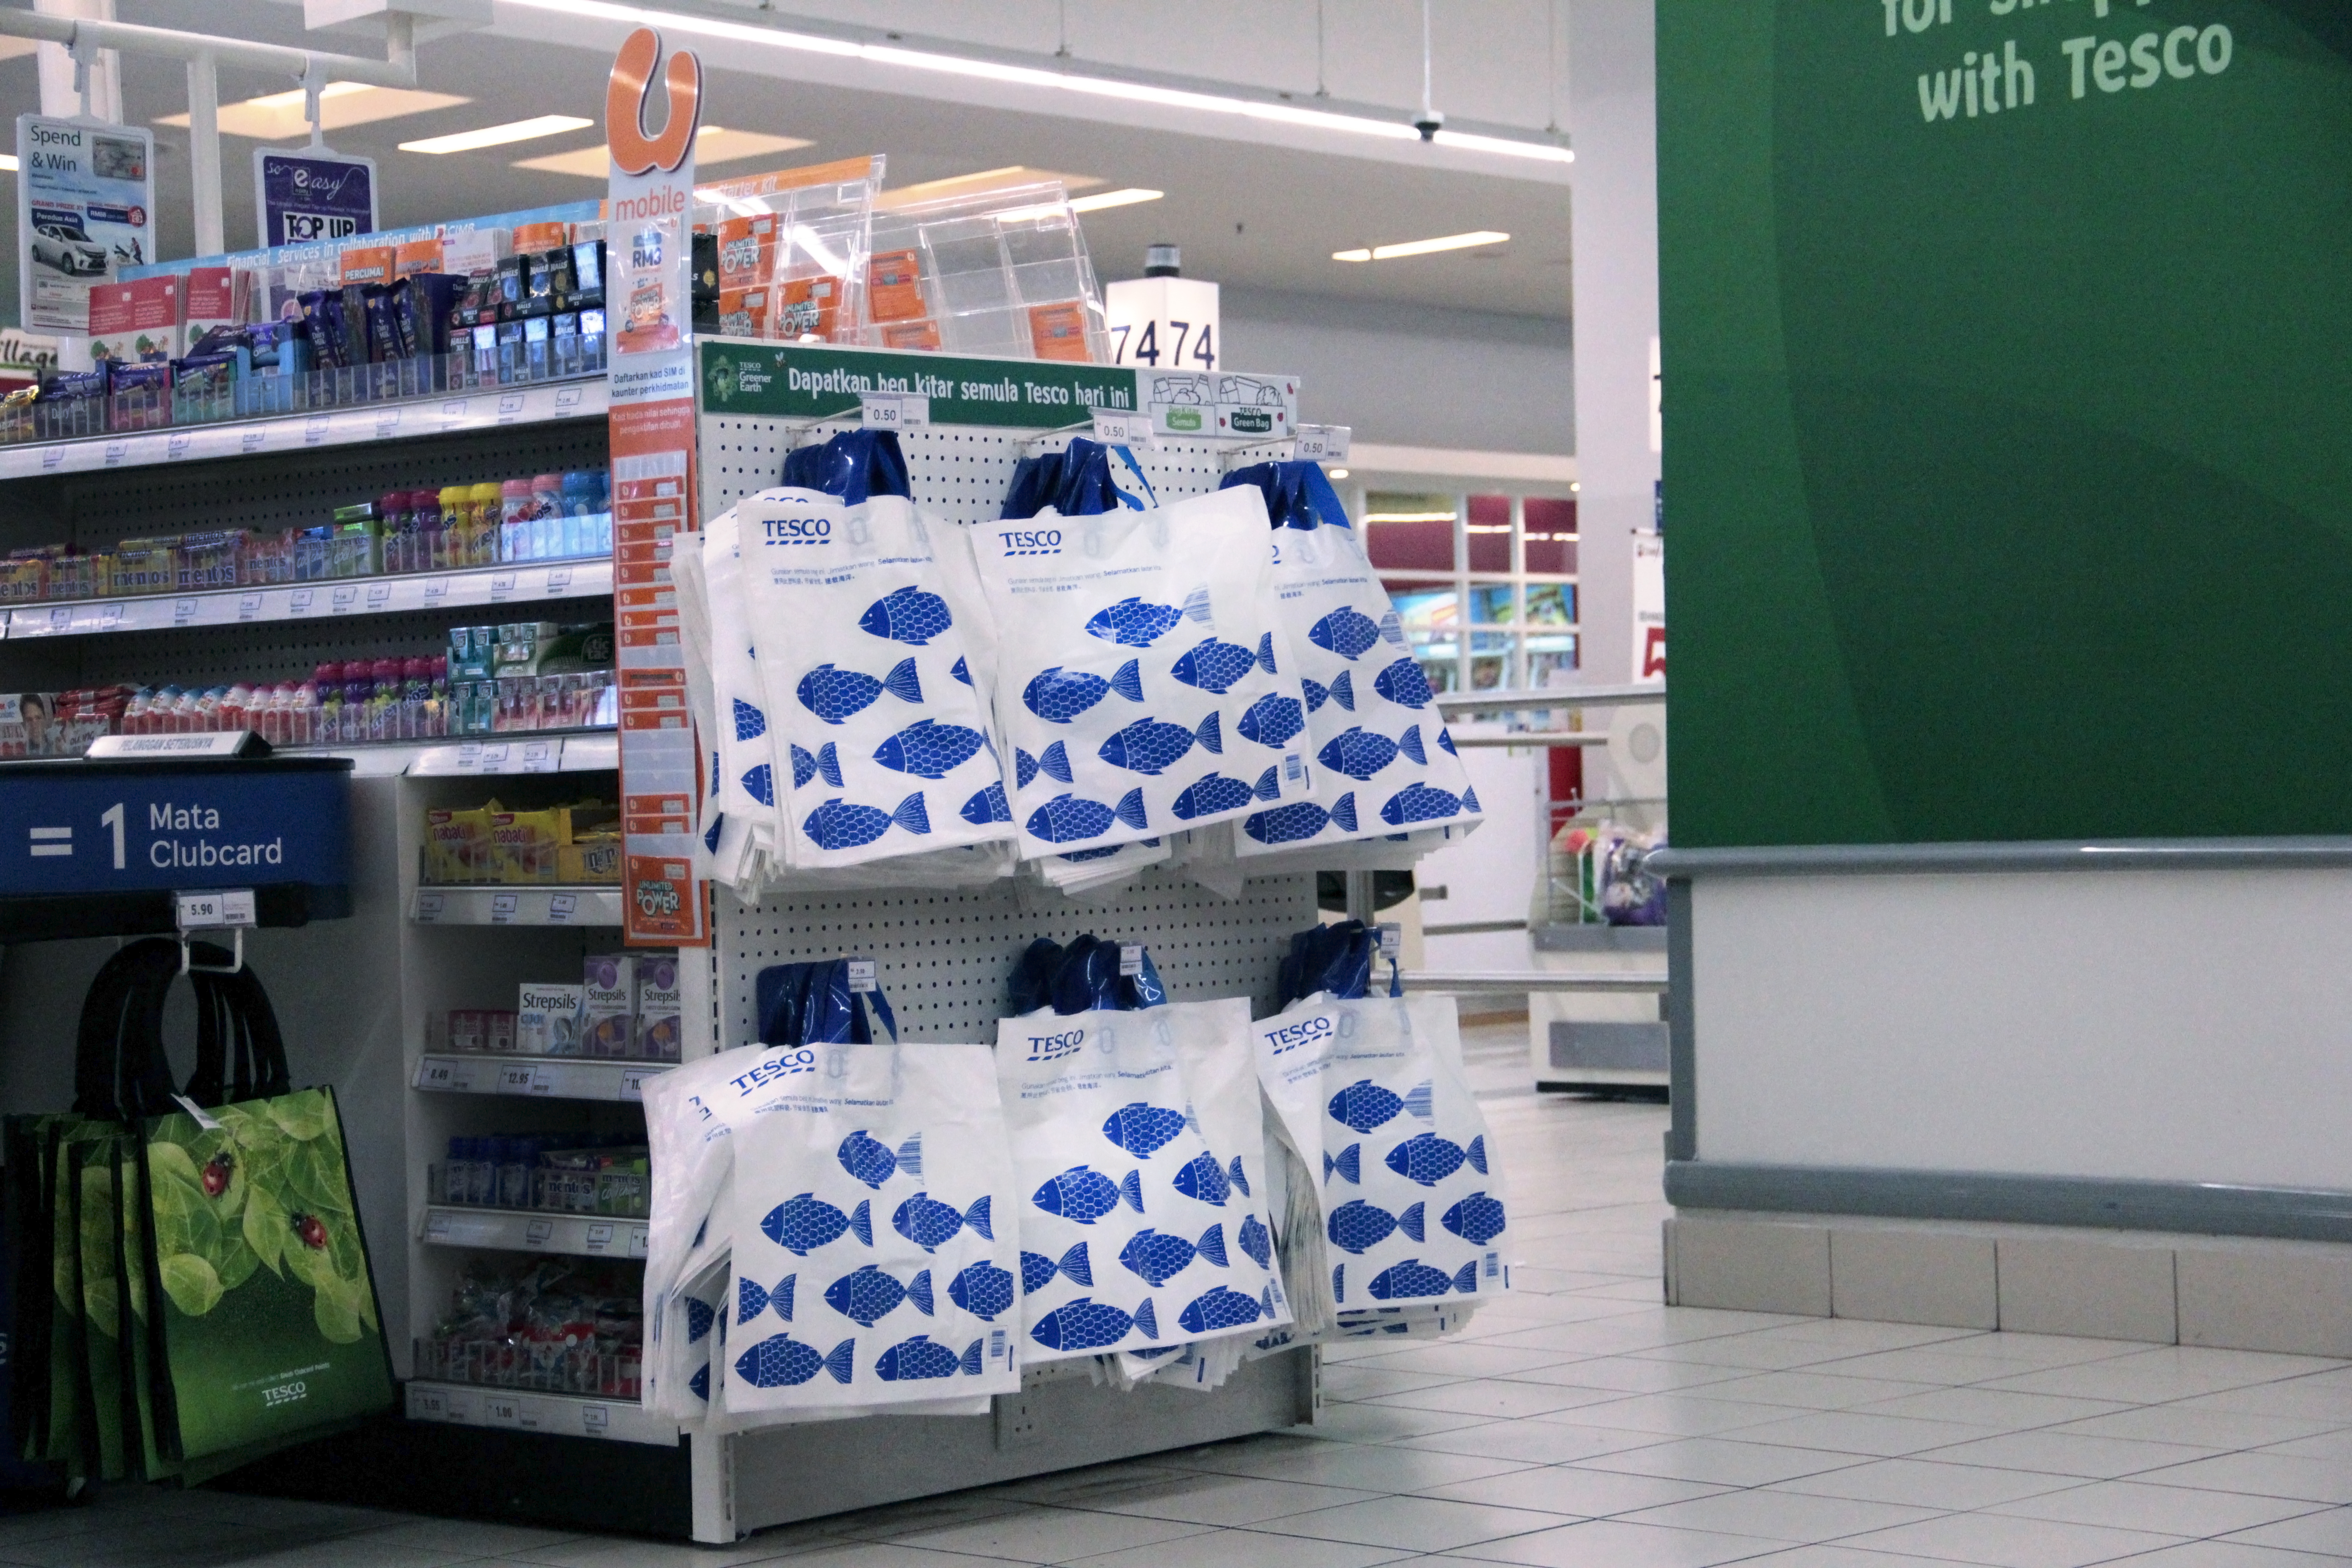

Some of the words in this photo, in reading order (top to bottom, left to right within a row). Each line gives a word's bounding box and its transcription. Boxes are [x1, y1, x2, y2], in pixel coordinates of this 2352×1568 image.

[1917, 39, 2035, 122] with
[2061, 24, 2233, 100] Tesco
[31, 125, 81, 146] Spend
[32, 152, 43, 168] &
[46, 153, 76, 172] Win
[616, 185, 685, 221] mobile
[37, 212, 63, 221] Perodua
[285, 214, 324, 239] TOP
[329, 219, 354, 239] UP
[226, 250, 270, 268] Financial
[278, 244, 320, 264] Services
[323, 242, 333, 257] in
[409, 226, 431, 242] with
[725, 237, 759, 250] UNLIMITED
[550, 261, 567, 271] HALLS
[721, 245, 761, 274] POWER
[344, 266, 384, 281] PERCUMA!
[568, 294, 583, 302] HALLS
[783, 300, 817, 314] UNLIMITED
[778, 309, 820, 337] POWER
[450, 336, 470, 347] HALLS
[1111, 320, 1160, 367] 74
[1170, 321, 1215, 370] 74
[614, 372, 648, 384] Daftarkan
[650, 369, 662, 379] kad
[663, 367, 677, 377] SIM
[678, 366, 686, 376] di
[739, 371, 772, 383] Greener
[612, 387, 638, 398] kaunter
[640, 380, 689, 396] perkhidmatan
[740, 381, 762, 392] Earth
[789, 367, 871, 400] Dapatkan
[915, 372, 955, 399] kitar
[960, 377, 1019, 402] semula
[1024, 382, 1069, 404] Tesco
[1074, 381, 1105, 407] hari
[1110, 386, 1129, 408] ini
[51, 406, 70, 419] Dairy
[644, 408, 658, 418] nilai
[659, 405, 691, 418] sehingga
[873, 409, 896, 421] 0.50
[1239, 407, 1262, 416] TESCO
[1172, 416, 1196, 427] Semula
[1234, 416, 1254, 427] Green
[1255, 418, 1269, 430] Bag
[619, 422, 659, 437] pengaktifan
[1104, 425, 1124, 437] 0.50
[1303, 442, 1323, 454] 0.50
[762, 519, 831, 537] TESCO
[186, 530, 227, 543] mentos
[999, 529, 1062, 548] TESCO
[178, 565, 234, 584] mentos
[828, 564, 857, 574] Jimatkan
[1103, 567, 1140, 576] Selamatkan
[114, 569, 169, 588] mentos
[0, 581, 37, 598] entos
[102, 803, 125, 869] 1
[150, 803, 220, 830] Mata
[432, 825, 466, 842] nabati
[493, 827, 526, 844] nabati
[150, 838, 282, 867] Clubcard
[638, 879, 673, 892] UNLIMITED
[637, 887, 680, 916] POWER
[191, 903, 213, 916] 5.90
[523, 992, 577, 1012] Strepsils
[588, 989, 626, 1003] Strepsils
[1265, 1017, 1330, 1047] TESCO
[1028, 1029, 1084, 1053] TESCO
[430, 1068, 448, 1080] 8.49
[730, 1049, 815, 1090] TESCO
[1117, 1070, 1146, 1079] Selamatk
[508, 1072, 529, 1084] 12.95
[631, 1078, 641, 1091] 11.
[844, 1098, 875, 1107] Selamatkan
[261, 1382, 306, 1401] TESCO
[495, 1406, 513, 1419] 1.00
